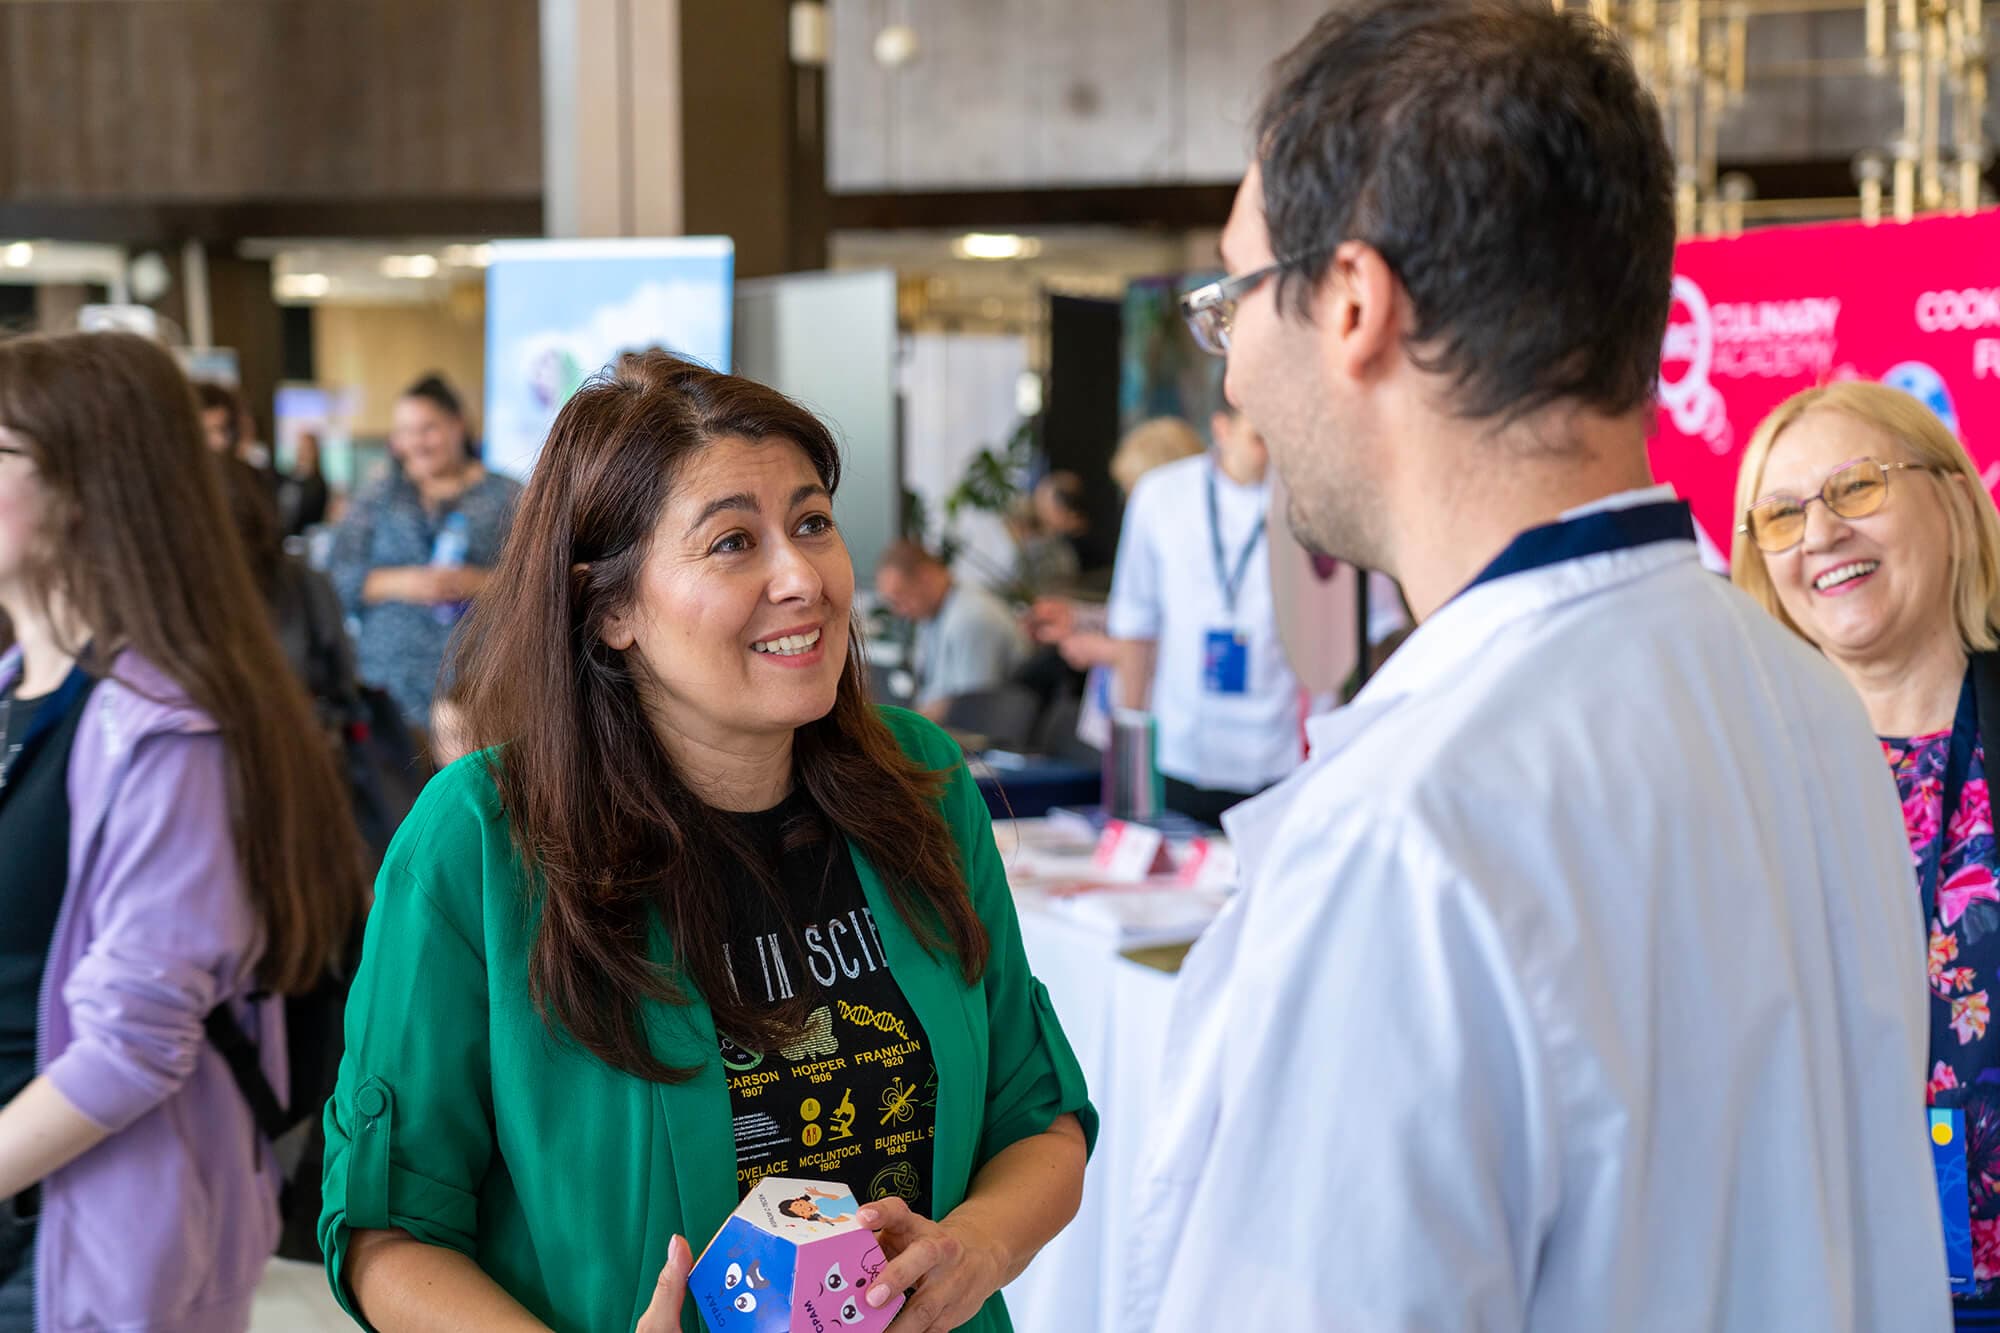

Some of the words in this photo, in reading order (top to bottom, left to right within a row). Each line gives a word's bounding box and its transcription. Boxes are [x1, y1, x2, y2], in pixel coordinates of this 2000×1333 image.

[755, 933, 795, 1002] IN
[741, 1085, 763, 1098] 1907
[809, 1072, 832, 1084] 1906
[882, 1056, 904, 1068] 1920
[791, 1058, 847, 1078] HOPPER
[854, 1040, 921, 1065] FRANKLIN
[799, 1144, 862, 1168] MCCLINTOCK
[875, 1129, 925, 1150] BURNELL
[819, 1160, 841, 1173] 1902
[886, 1144, 908, 1156] 1943
[804, 1300, 824, 1333] СРАМ
